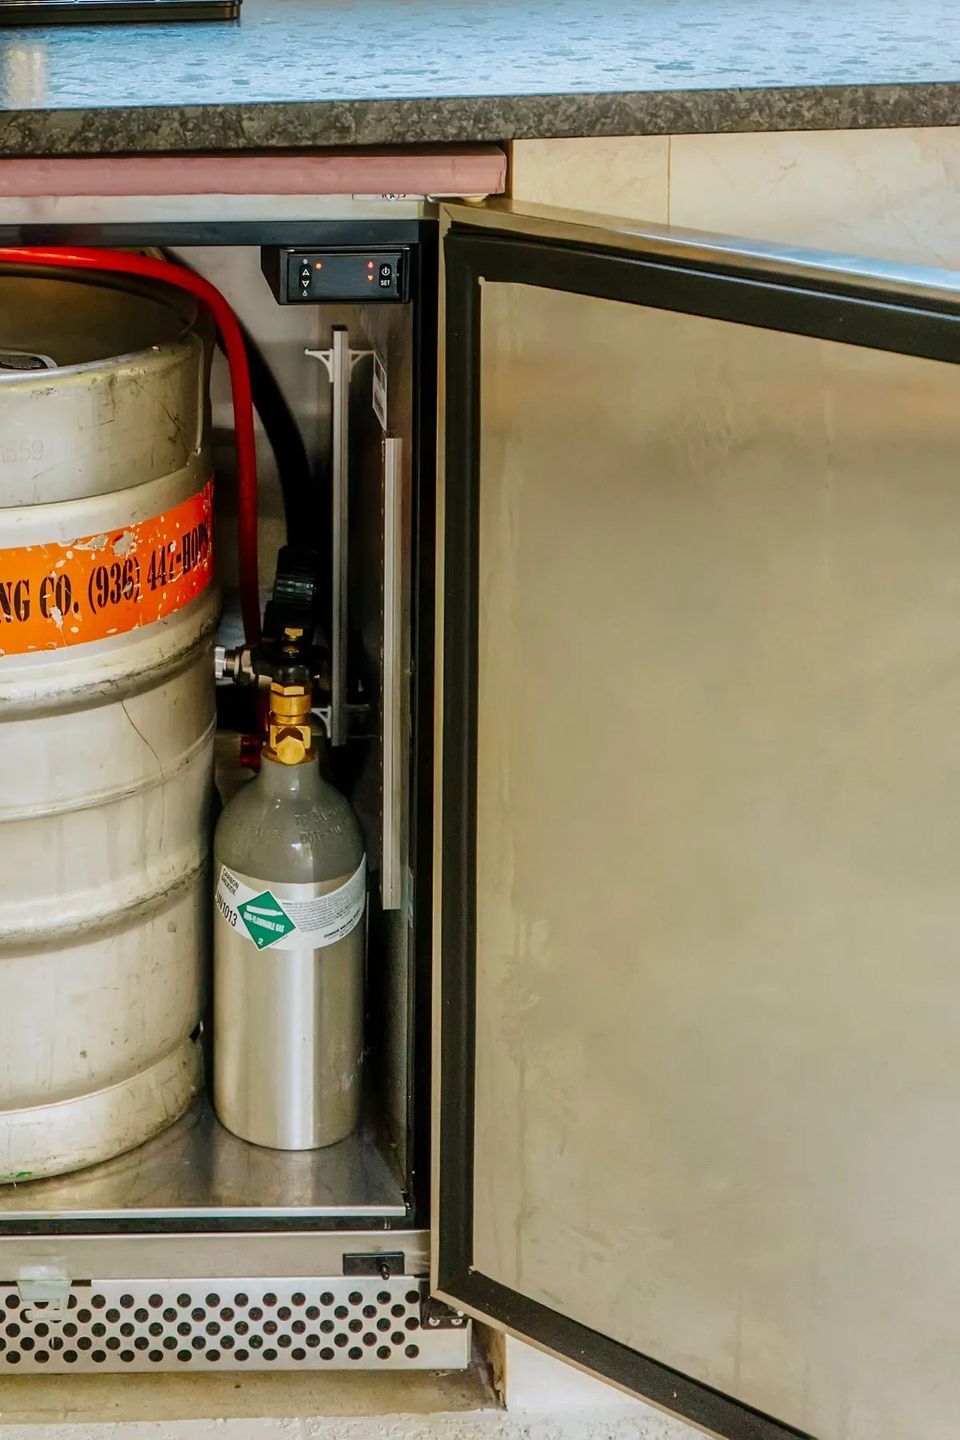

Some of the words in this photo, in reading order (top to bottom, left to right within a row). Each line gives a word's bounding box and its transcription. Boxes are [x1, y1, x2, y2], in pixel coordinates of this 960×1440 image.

[39, 574, 79, 619] CO.
[88, 557, 140, 615] (936)
[258, 937, 264, 946] 2
